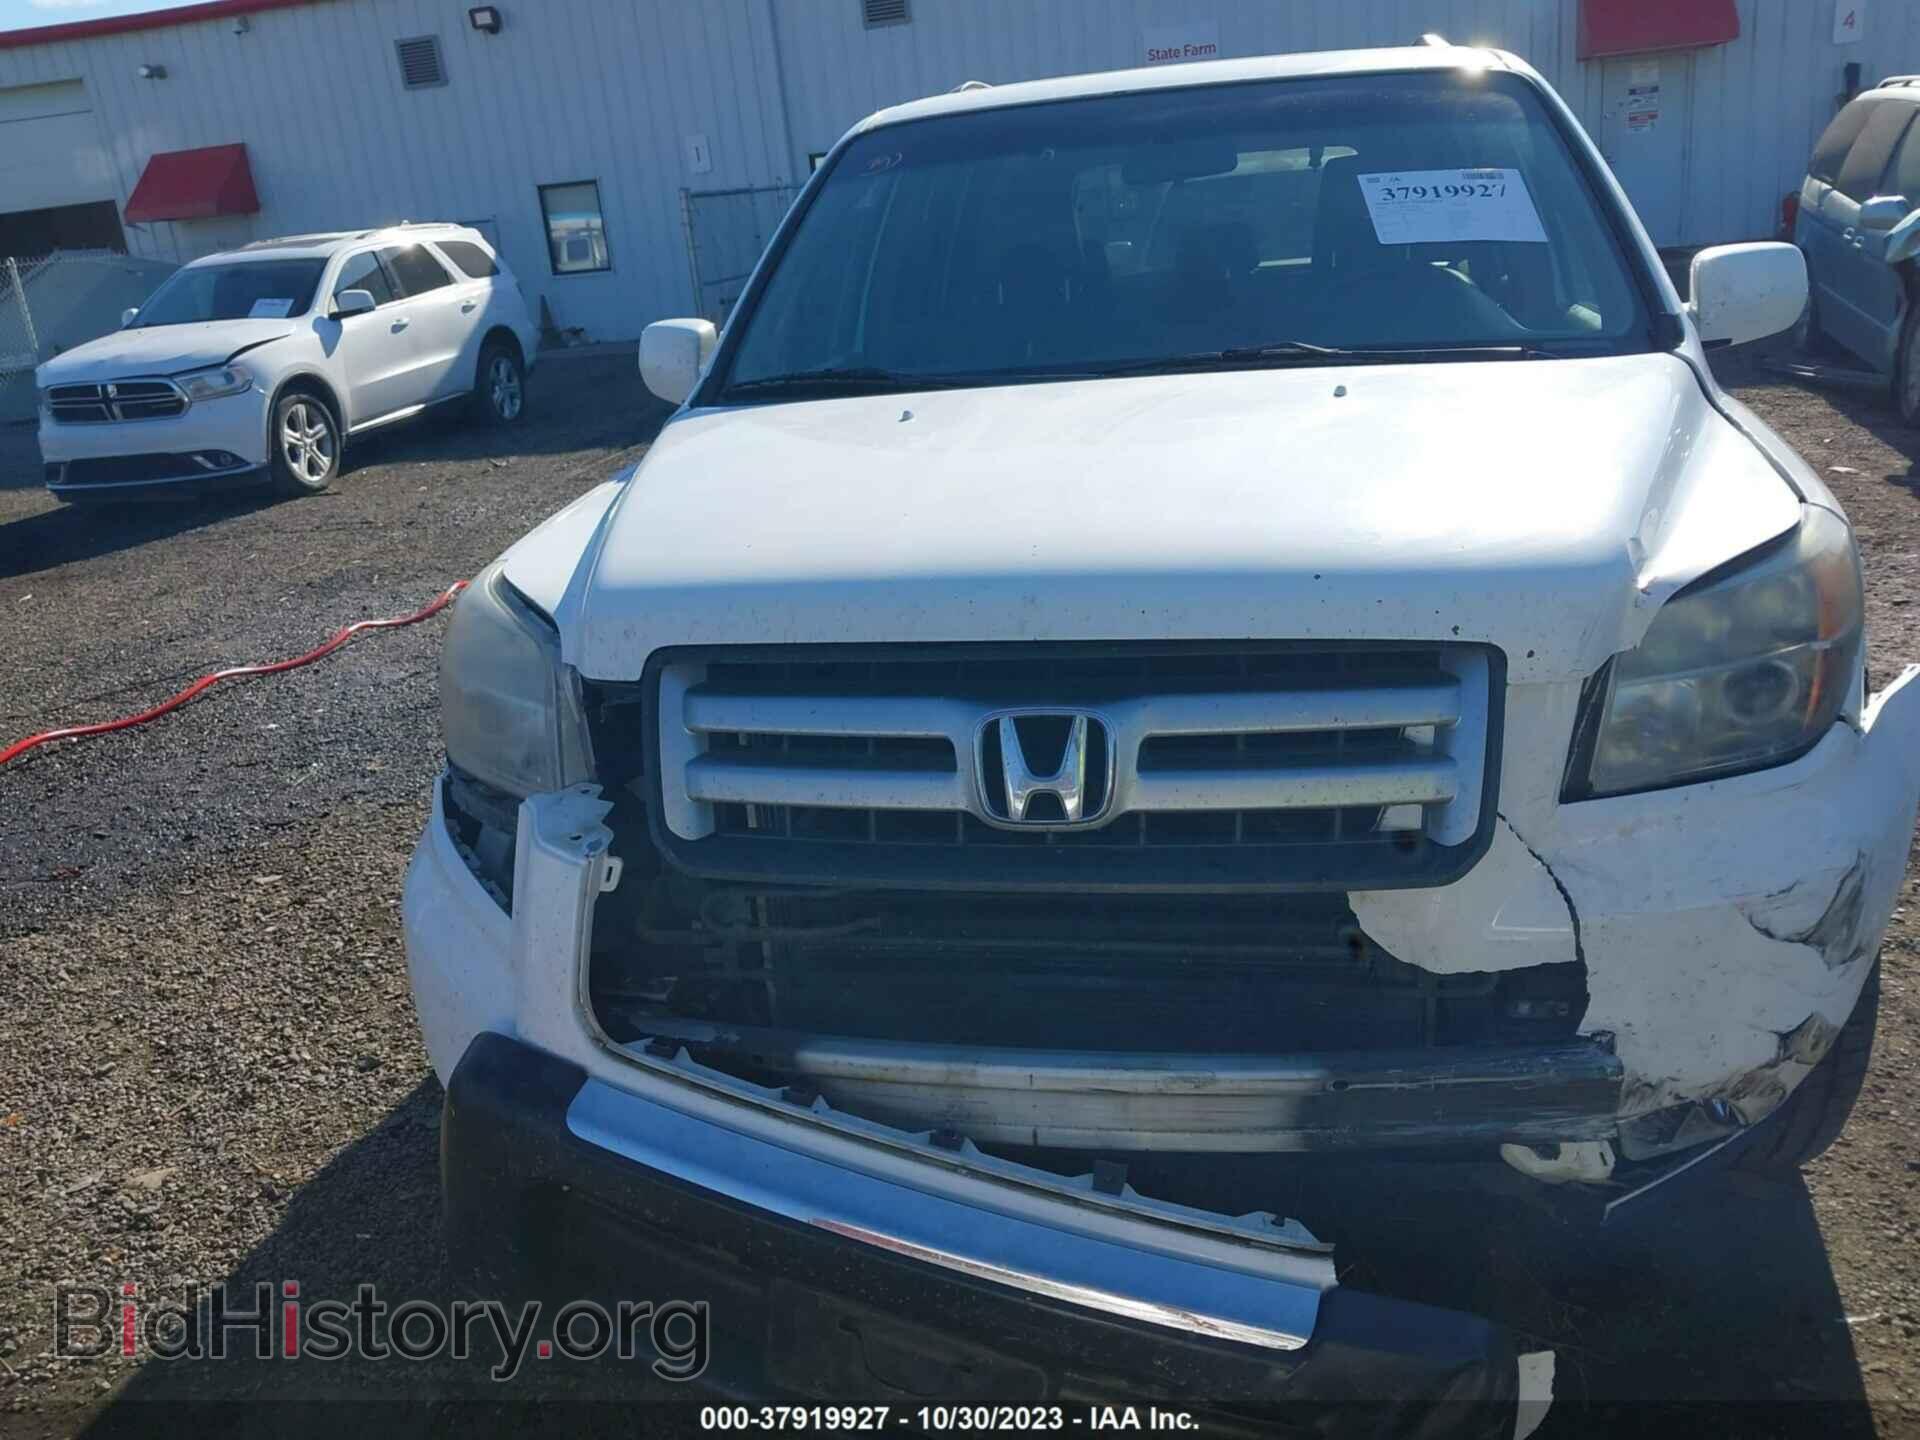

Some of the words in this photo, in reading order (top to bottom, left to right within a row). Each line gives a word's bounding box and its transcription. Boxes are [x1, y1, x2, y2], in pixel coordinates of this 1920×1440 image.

[1147, 48, 1180, 61] State
[1184, 43, 1216, 57] Farm
[1381, 184, 1505, 201] 37919927
